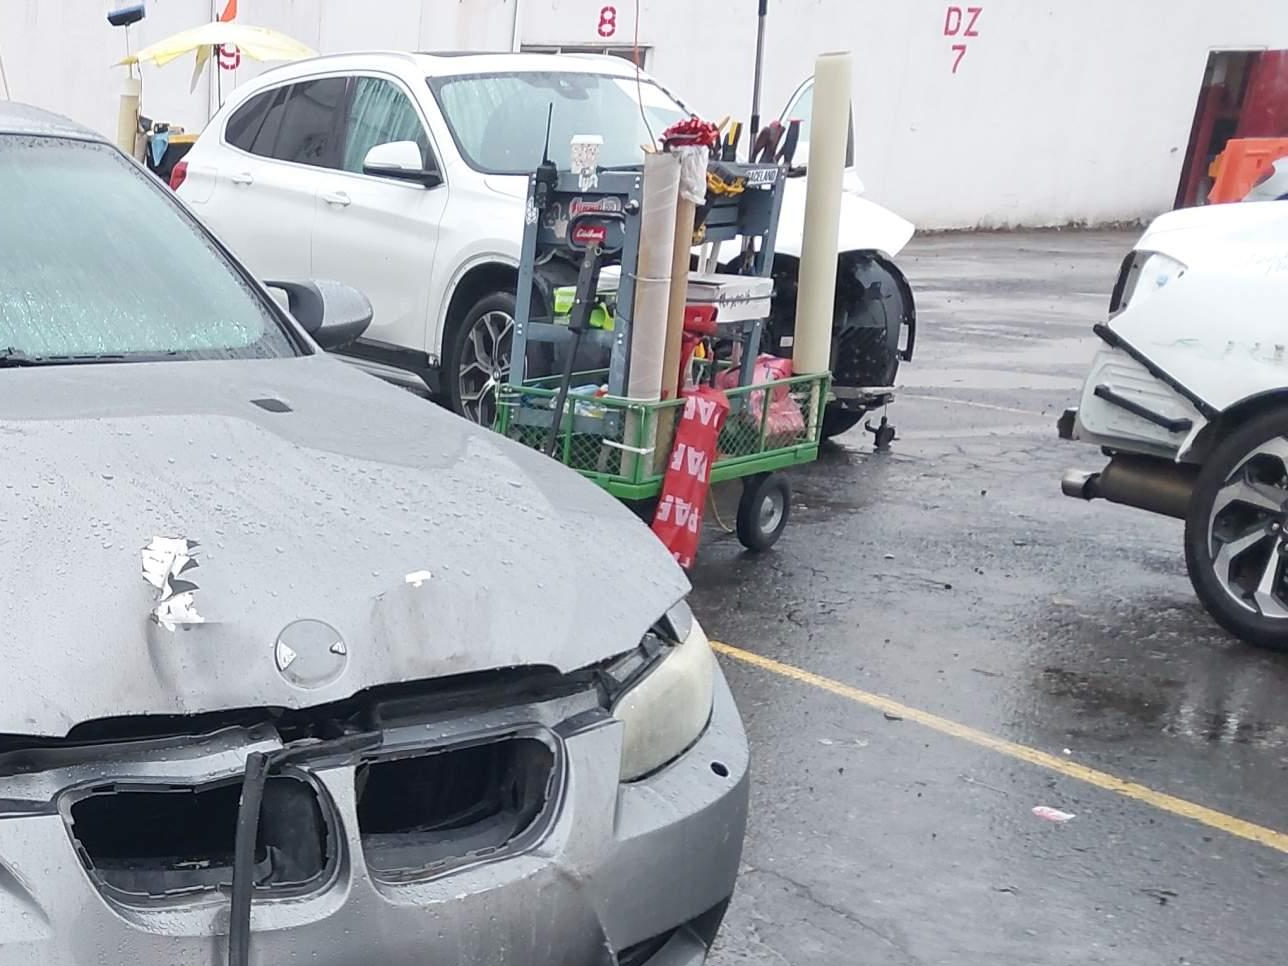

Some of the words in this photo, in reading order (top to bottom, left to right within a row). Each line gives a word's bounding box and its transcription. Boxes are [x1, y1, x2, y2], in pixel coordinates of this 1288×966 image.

[597, 6, 617, 37] 8
[944, 6, 983, 36] DZ
[951, 44, 967, 73] 7
